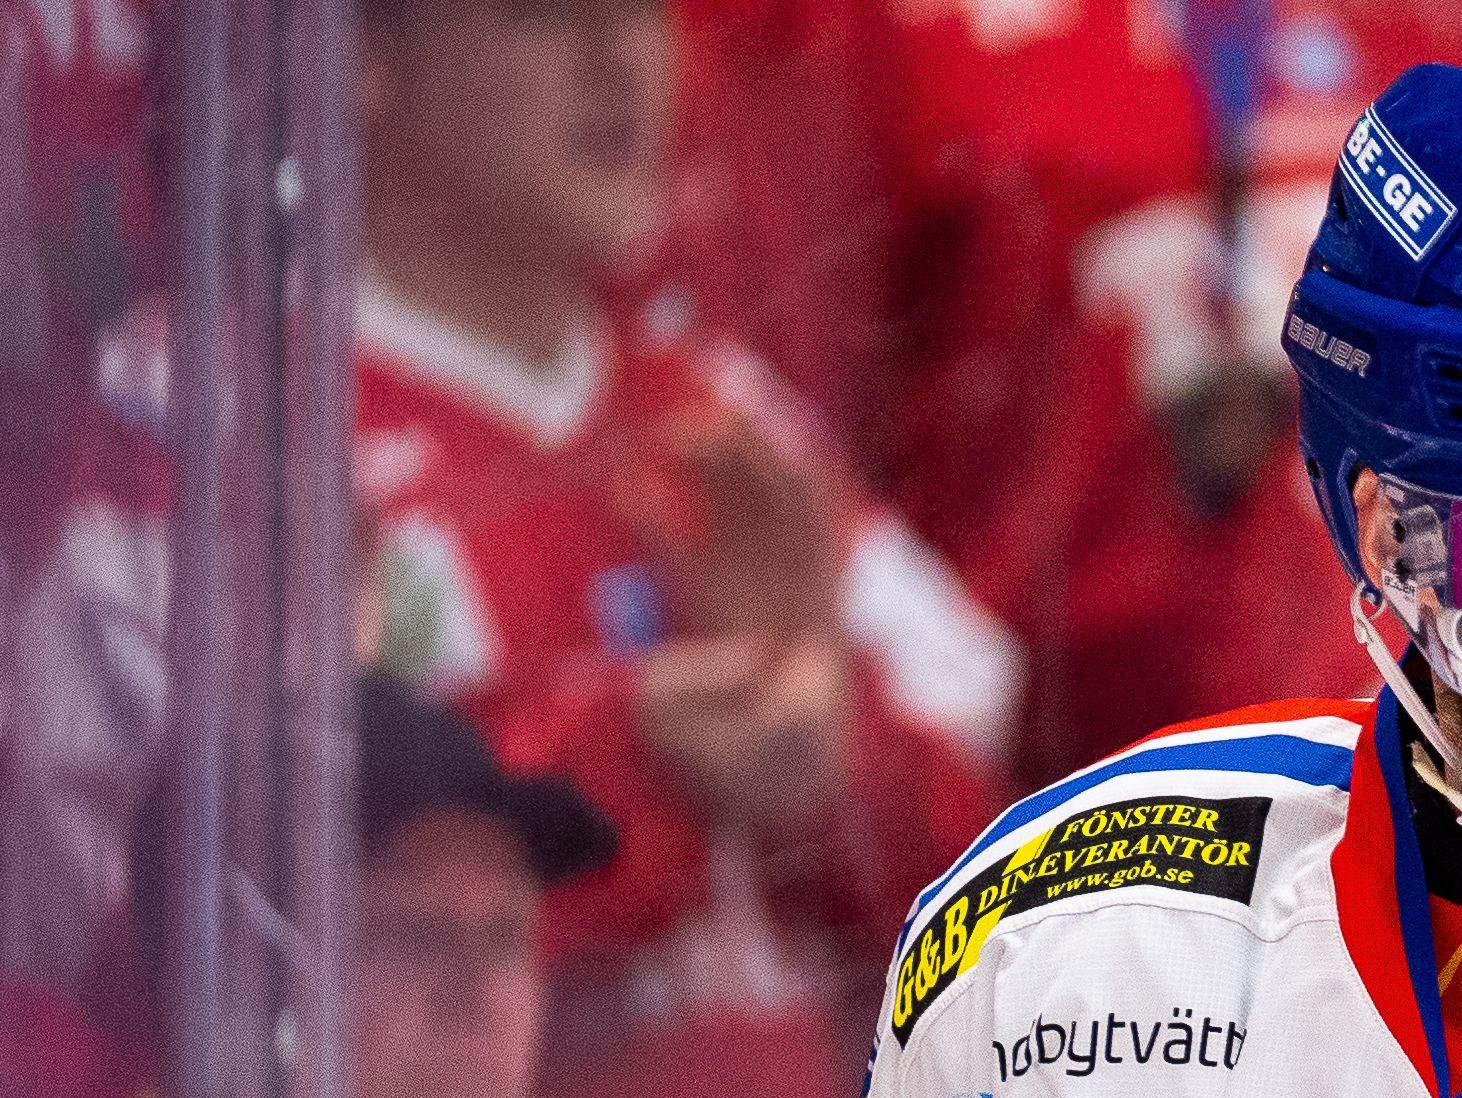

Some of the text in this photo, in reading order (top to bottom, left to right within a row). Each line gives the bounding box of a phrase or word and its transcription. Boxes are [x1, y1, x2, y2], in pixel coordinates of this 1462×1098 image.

[1346, 117, 1433, 232] BE-GE
[1060, 804, 1219, 844] FÖNSTER
[1045, 860, 1195, 899] www.gob.se
[892, 896, 969, 1028] G&B
